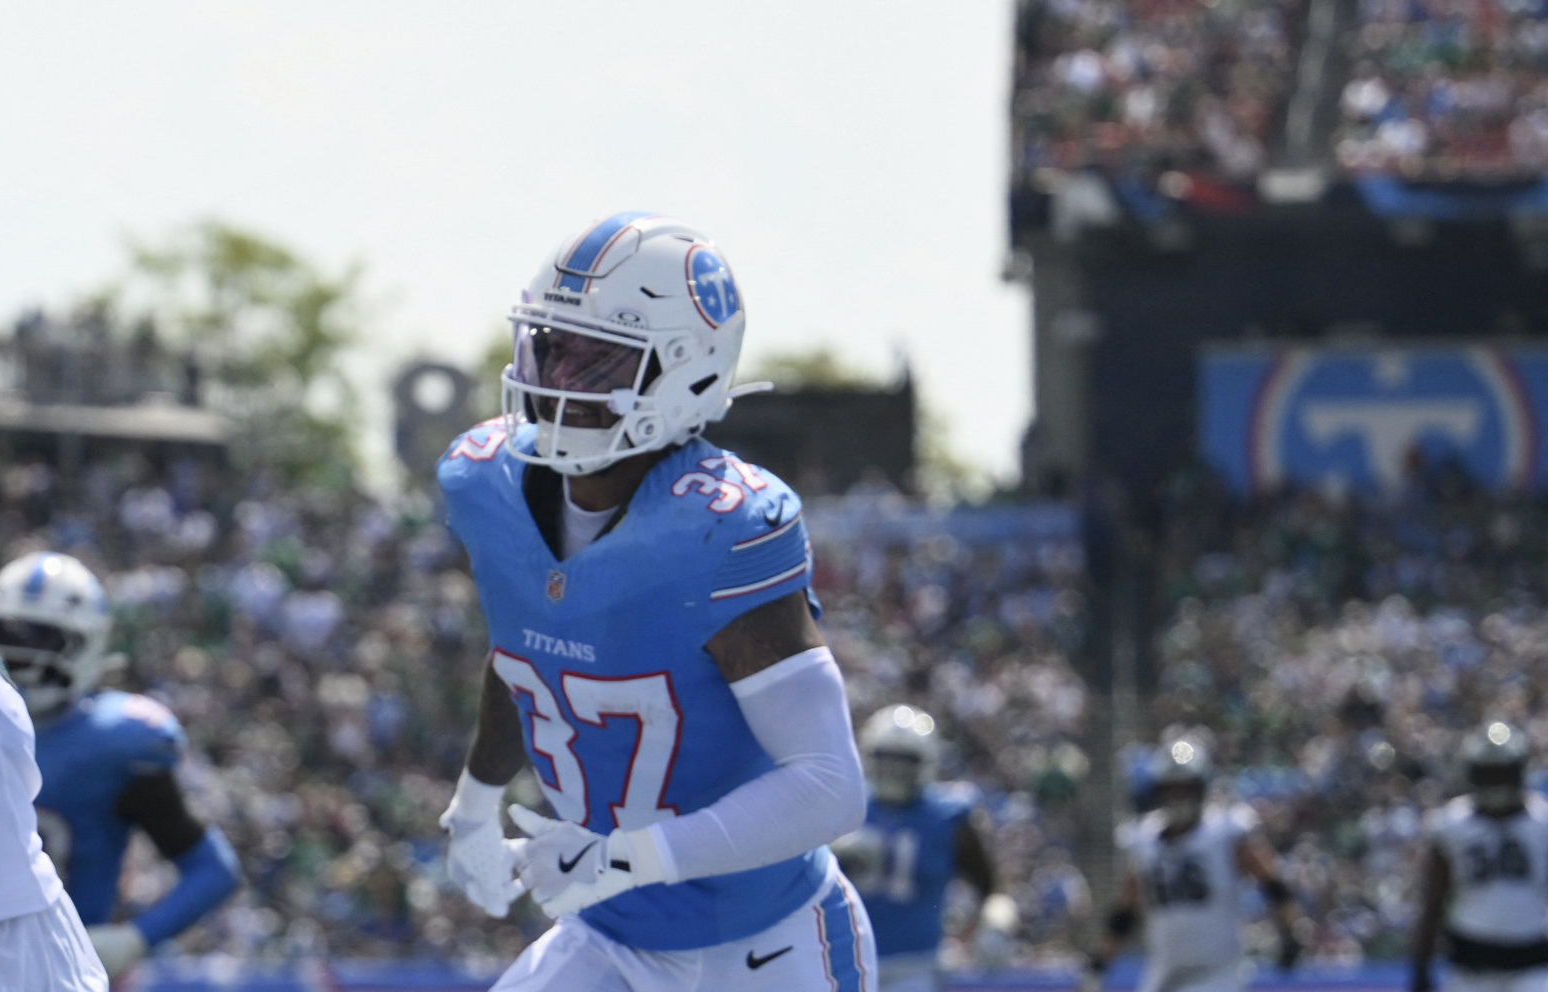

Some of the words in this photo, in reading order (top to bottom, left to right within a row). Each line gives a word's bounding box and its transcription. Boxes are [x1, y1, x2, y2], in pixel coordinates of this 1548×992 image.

[671, 456, 768, 513] 37
[523, 628, 597, 663] TITANS
[492, 646, 684, 829] 37
